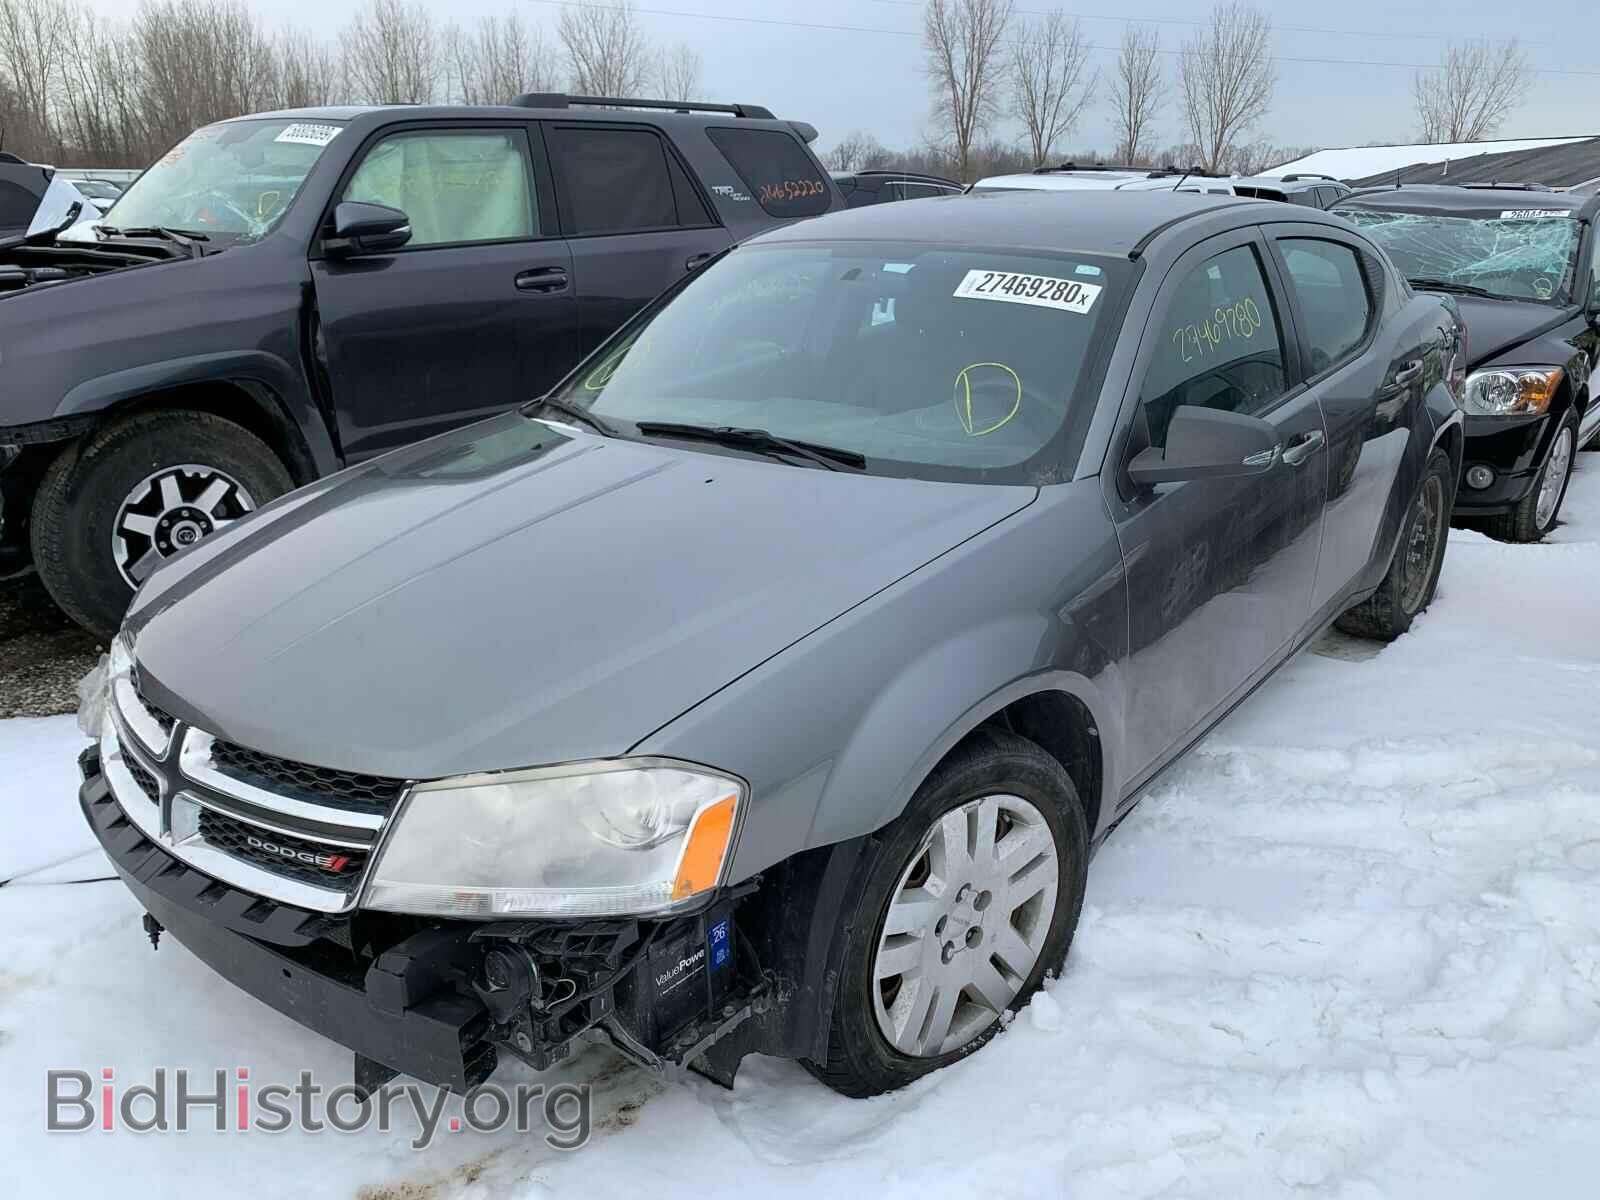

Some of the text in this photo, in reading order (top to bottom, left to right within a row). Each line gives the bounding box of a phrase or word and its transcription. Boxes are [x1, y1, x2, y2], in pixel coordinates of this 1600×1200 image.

[1172, 297, 1261, 362] 27469280
[953, 362, 1022, 437] D
[247, 836, 334, 868] DODGE
[655, 949, 705, 986] ValuePowe
